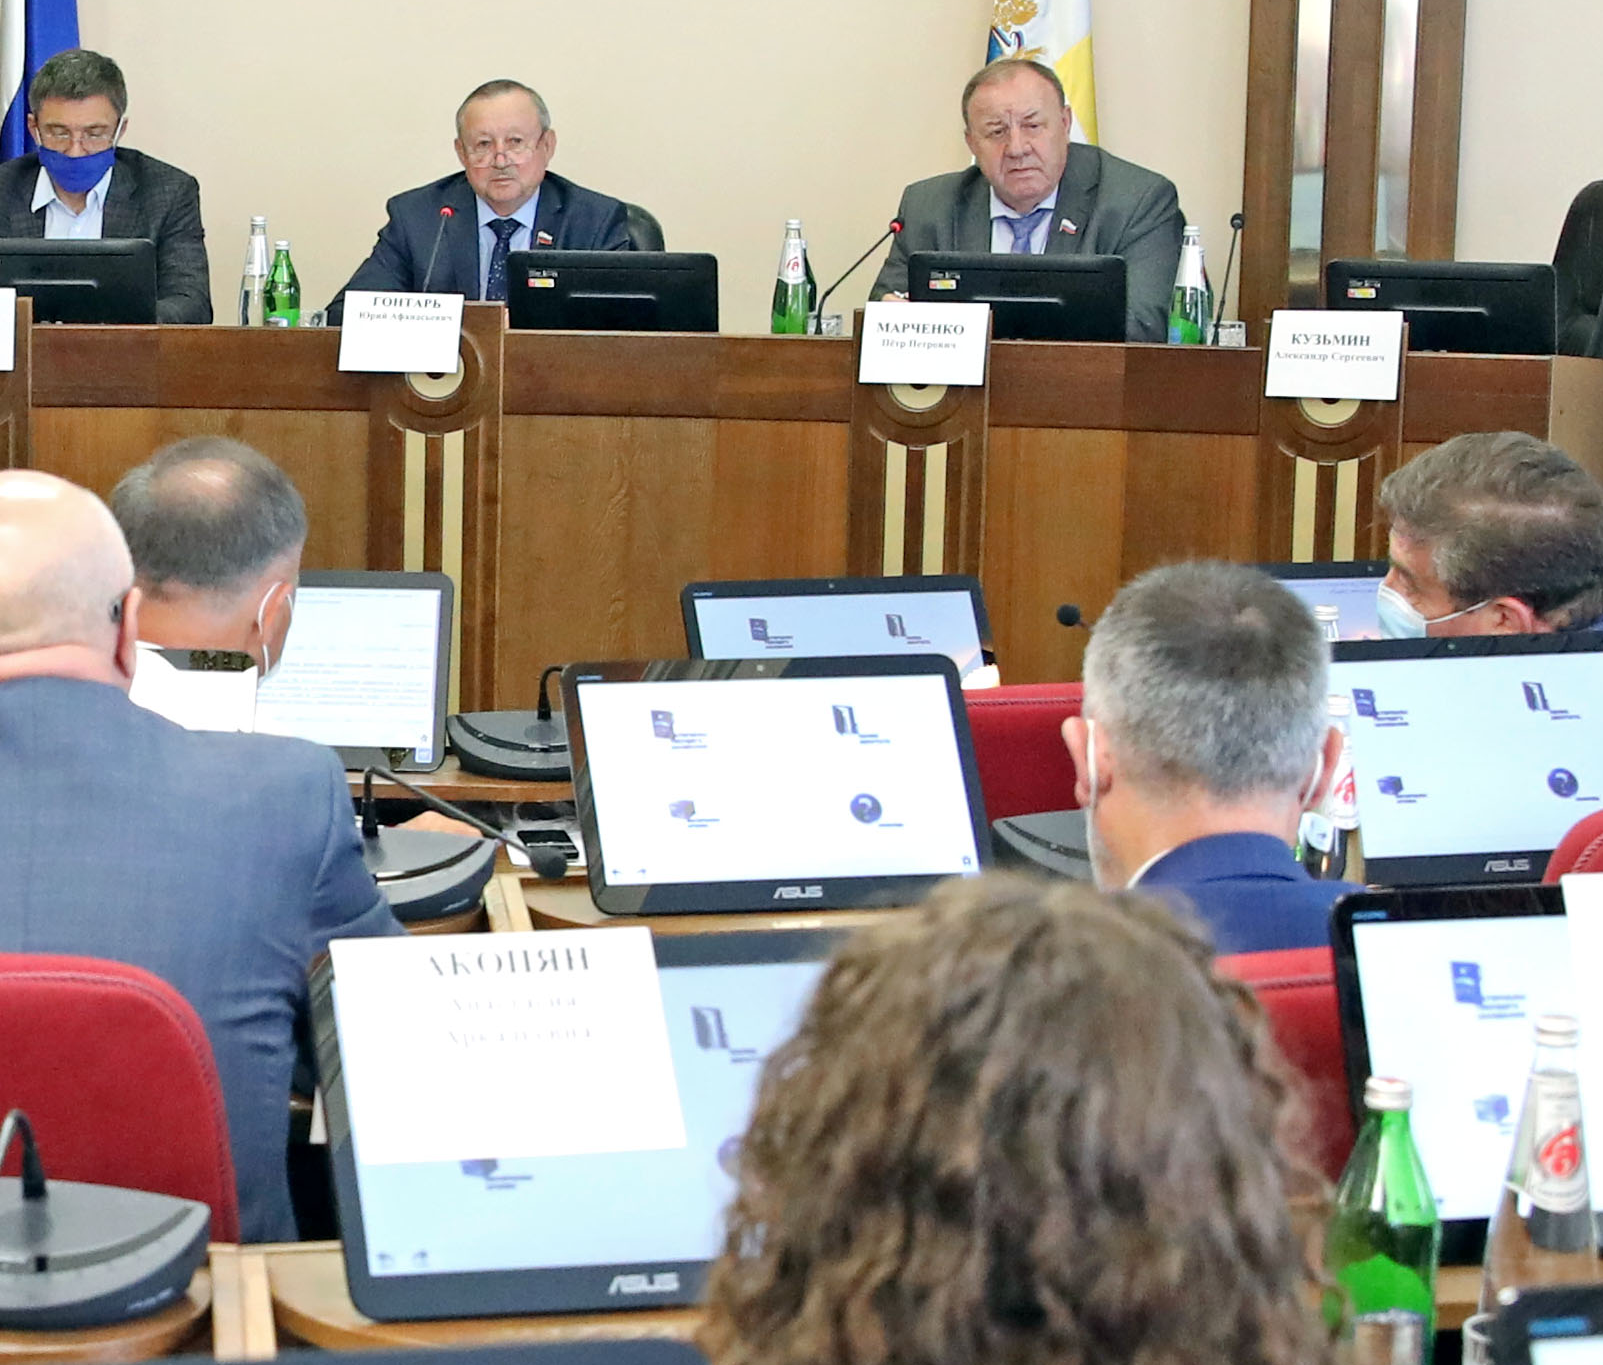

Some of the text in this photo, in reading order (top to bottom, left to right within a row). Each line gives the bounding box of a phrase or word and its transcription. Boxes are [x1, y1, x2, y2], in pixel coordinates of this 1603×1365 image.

[373, 296, 442, 309] ГОНТАРЬ
[876, 321, 965, 336] МАРЧЕНКО
[881, 338, 957, 350] Пётр Петрович
[1291, 333, 1371, 347] КУЗЬМИН
[1274, 351, 1385, 363] Александр Сергеевич
[1484, 858, 1531, 873] ASUS
[773, 885, 824, 899] ASUS
[607, 1271, 680, 1295] ASUS
